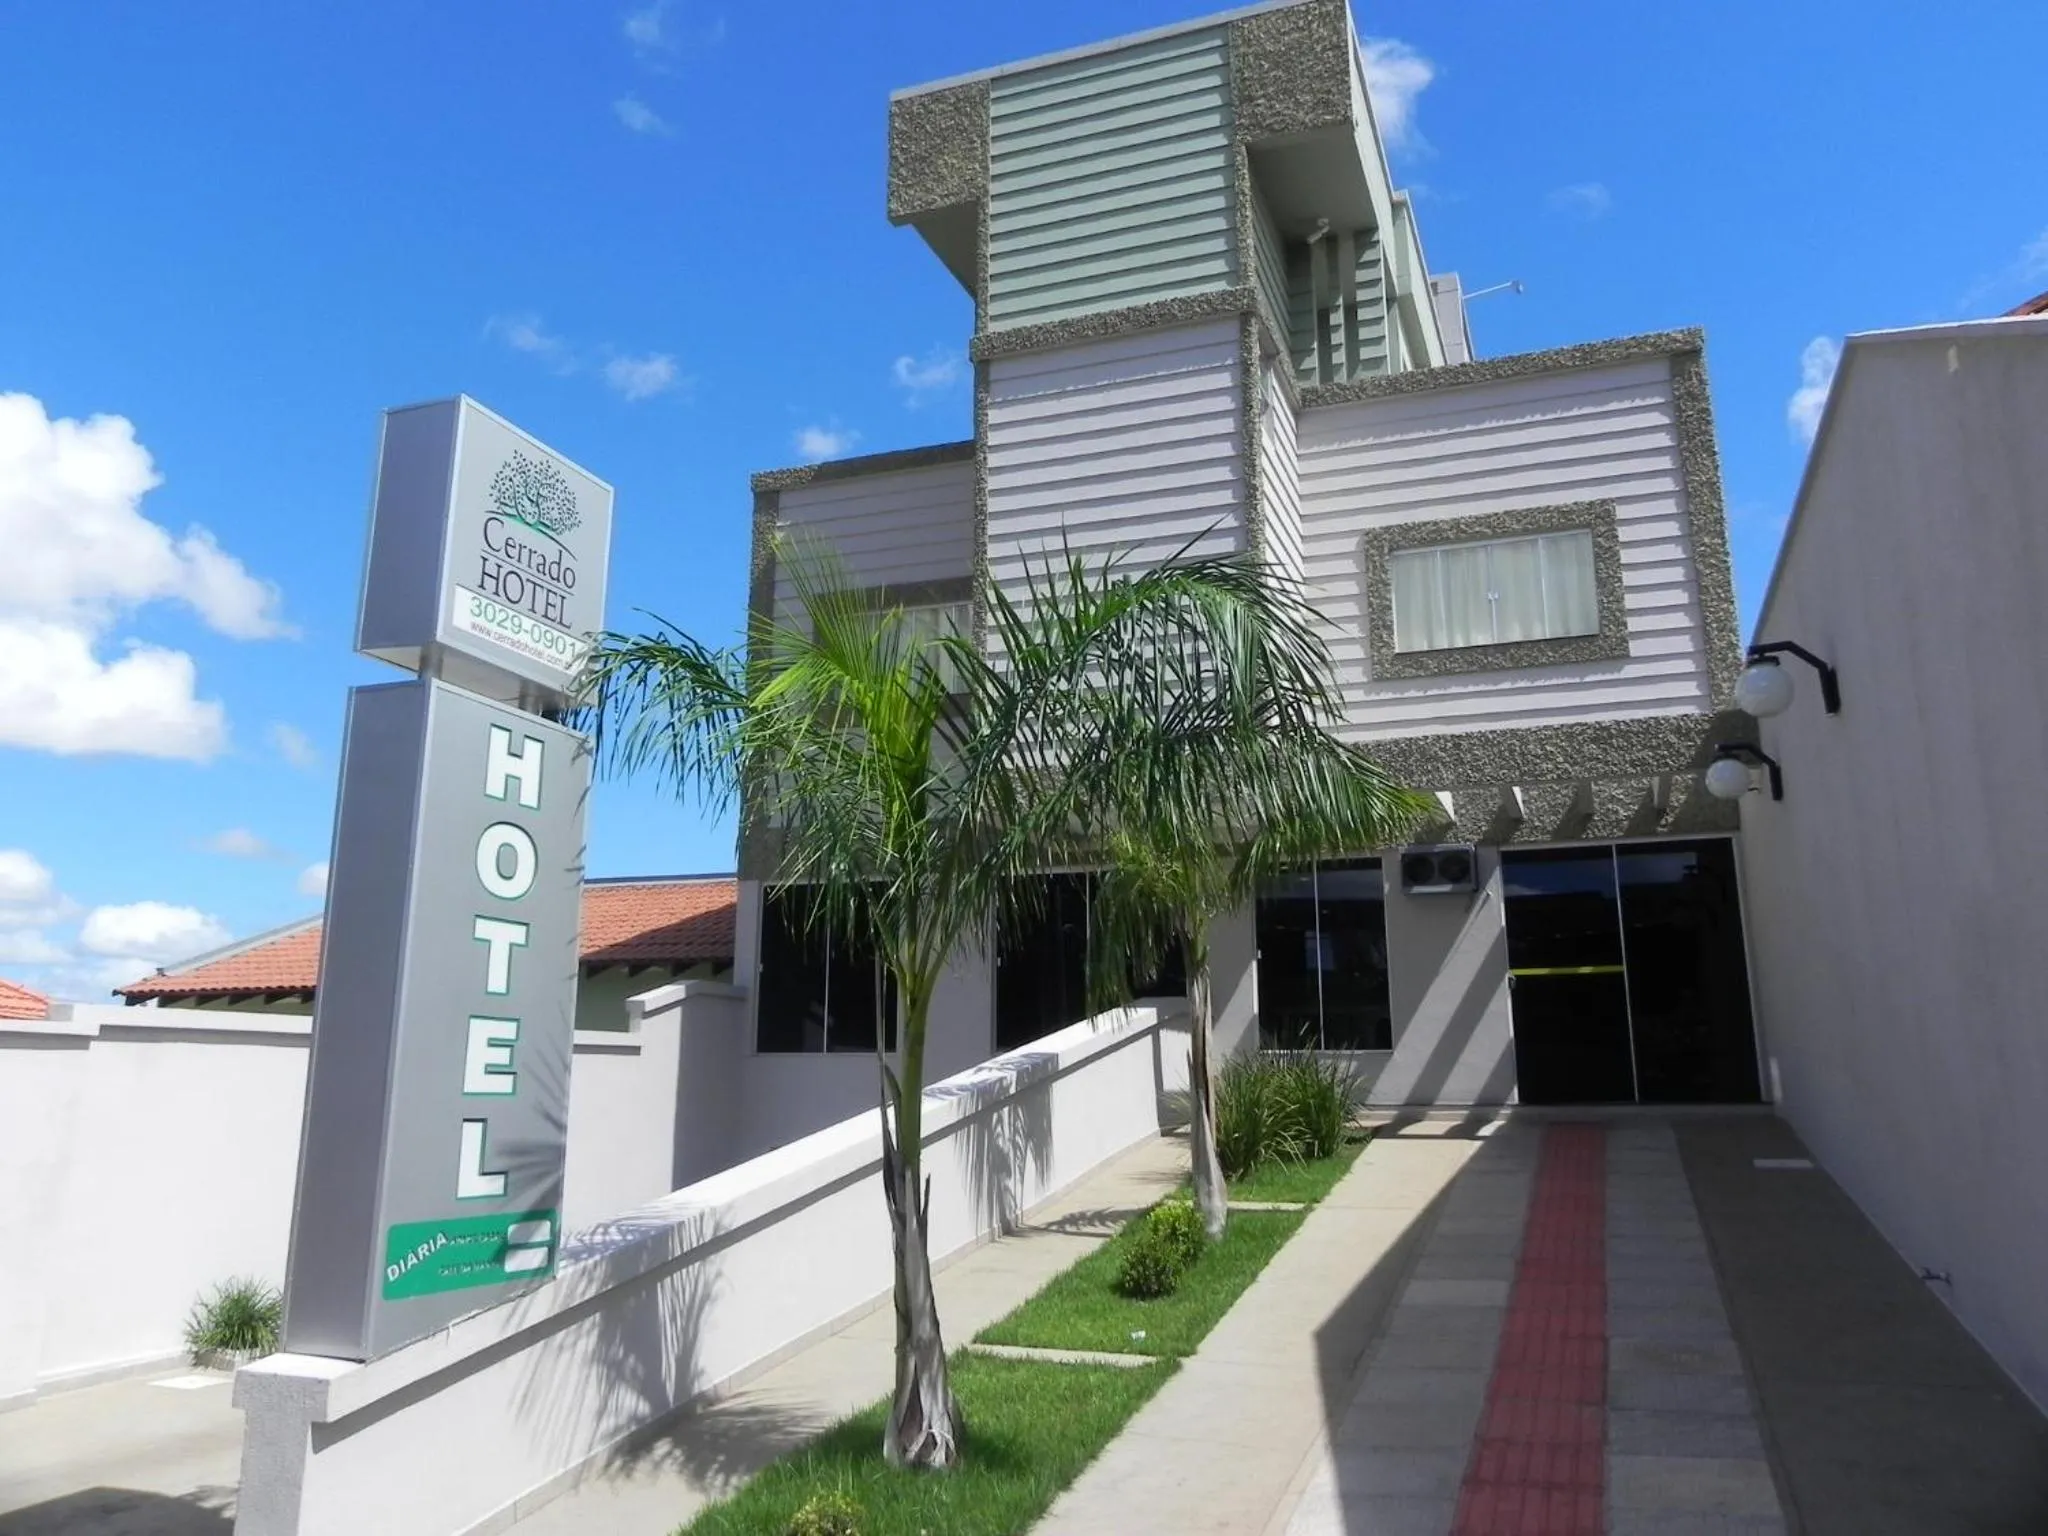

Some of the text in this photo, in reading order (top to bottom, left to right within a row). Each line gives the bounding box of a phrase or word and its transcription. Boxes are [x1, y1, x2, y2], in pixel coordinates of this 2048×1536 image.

[483, 516, 576, 589] Cerrado
[470, 596, 576, 658] 3029-0901
[478, 555, 573, 629] HOTEL
[456, 723, 546, 1200] HOTEL
